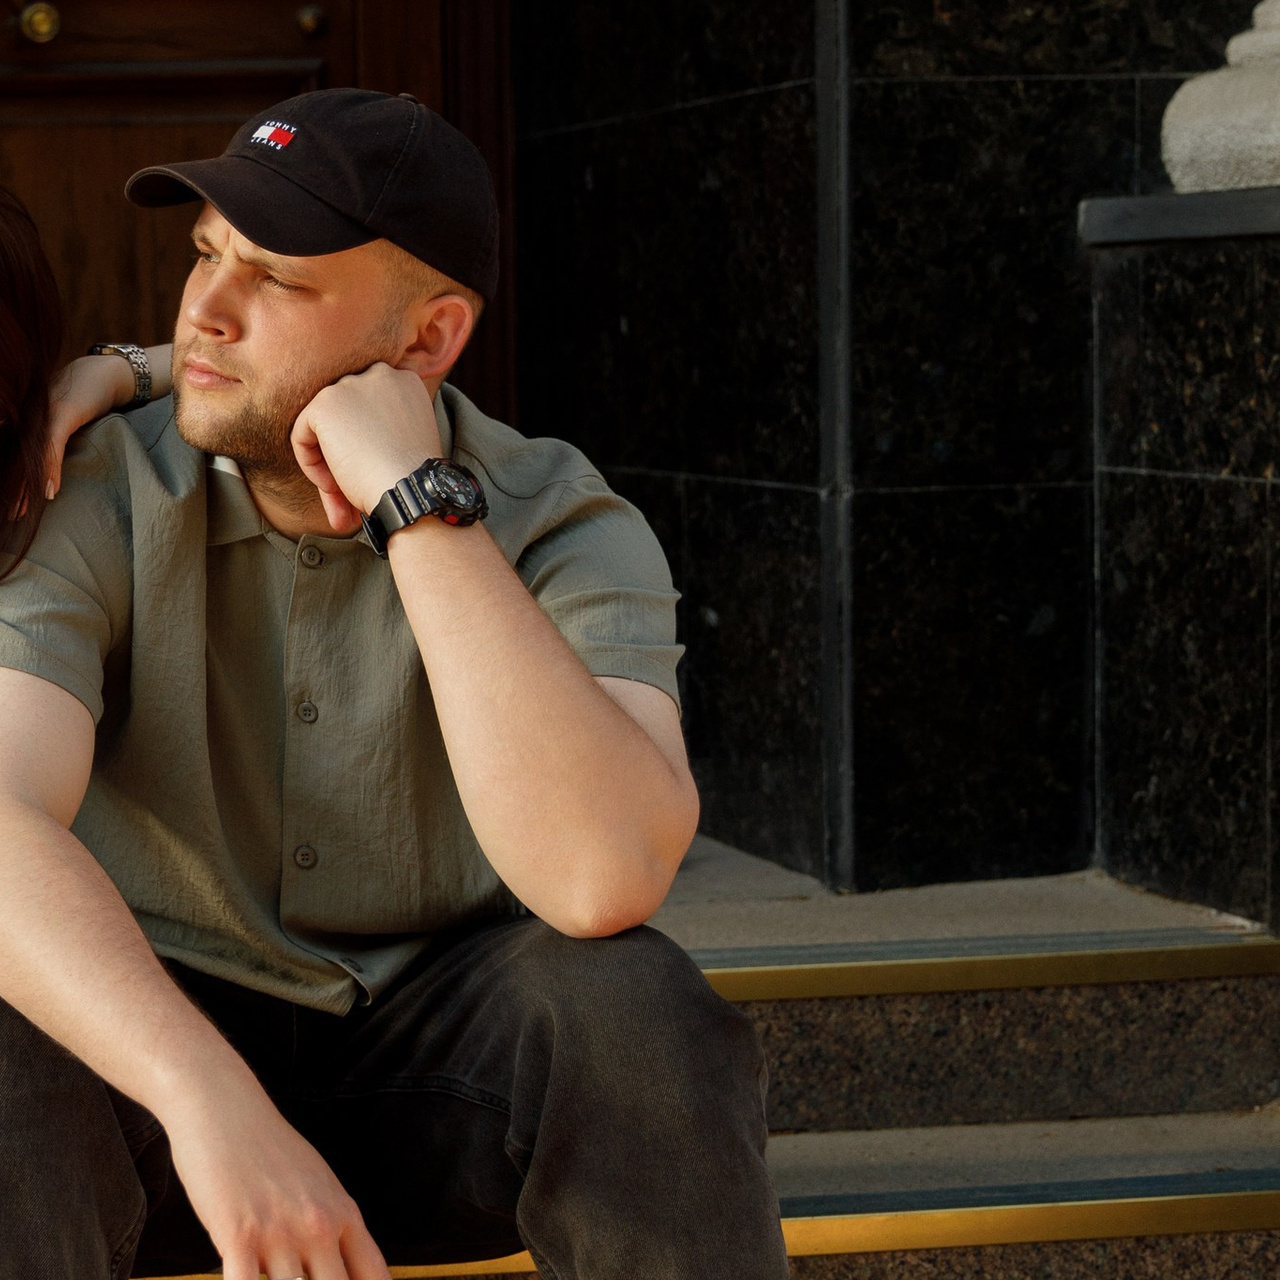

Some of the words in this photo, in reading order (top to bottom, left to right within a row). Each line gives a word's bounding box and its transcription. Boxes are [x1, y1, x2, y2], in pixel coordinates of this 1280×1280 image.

[265, 121, 297, 133] TOMMY
[251, 137, 282, 150] JEANS
[429, 470, 447, 499] G-SHOCK
